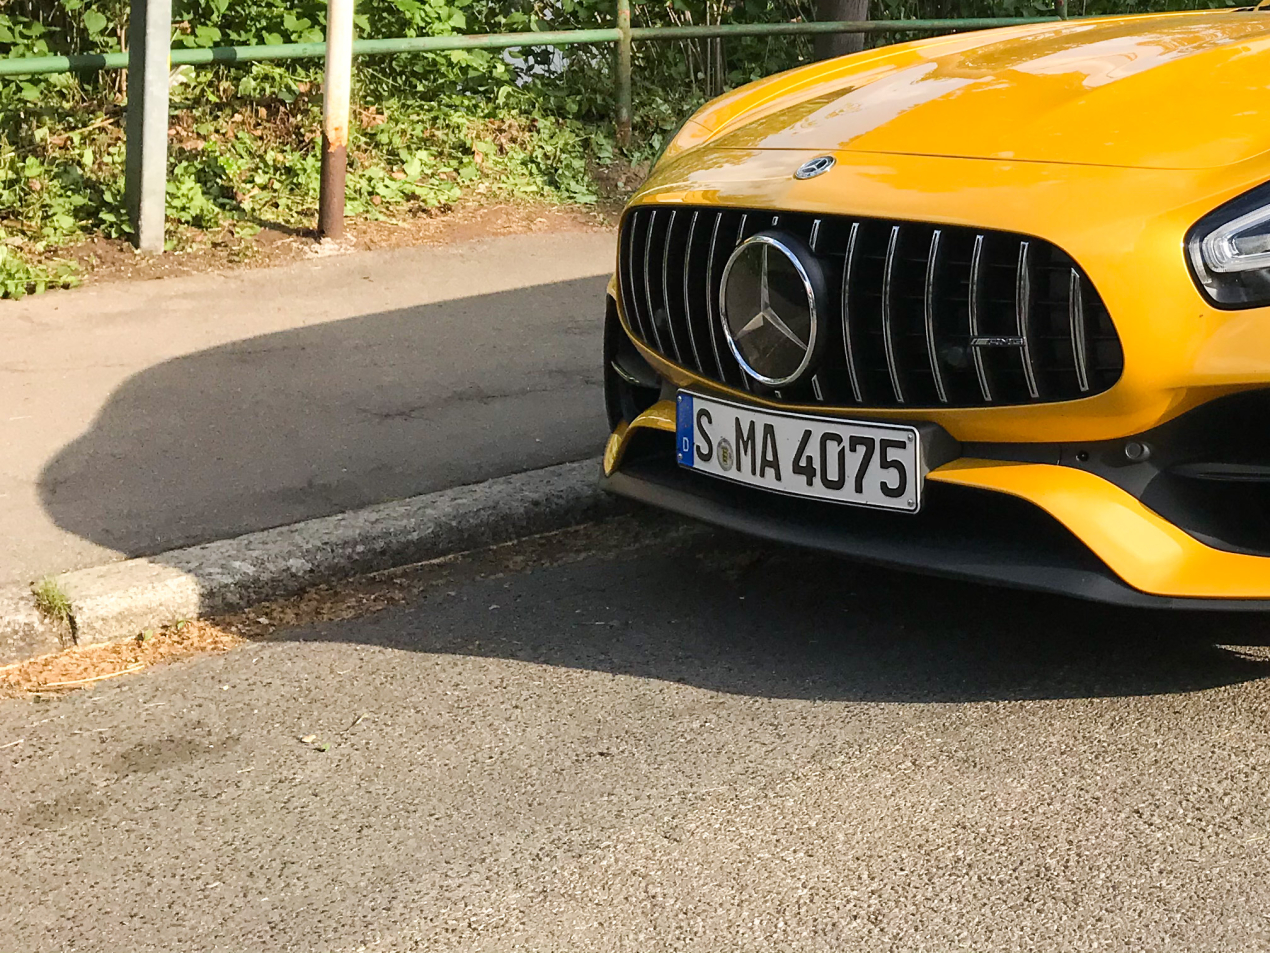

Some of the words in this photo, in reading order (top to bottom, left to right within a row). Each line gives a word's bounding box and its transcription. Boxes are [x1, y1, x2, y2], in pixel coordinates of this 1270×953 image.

[682, 437, 689, 452] D
[695, 408, 713, 462] S
[735, 416, 782, 482] MA
[792, 429, 907, 498] 4075
